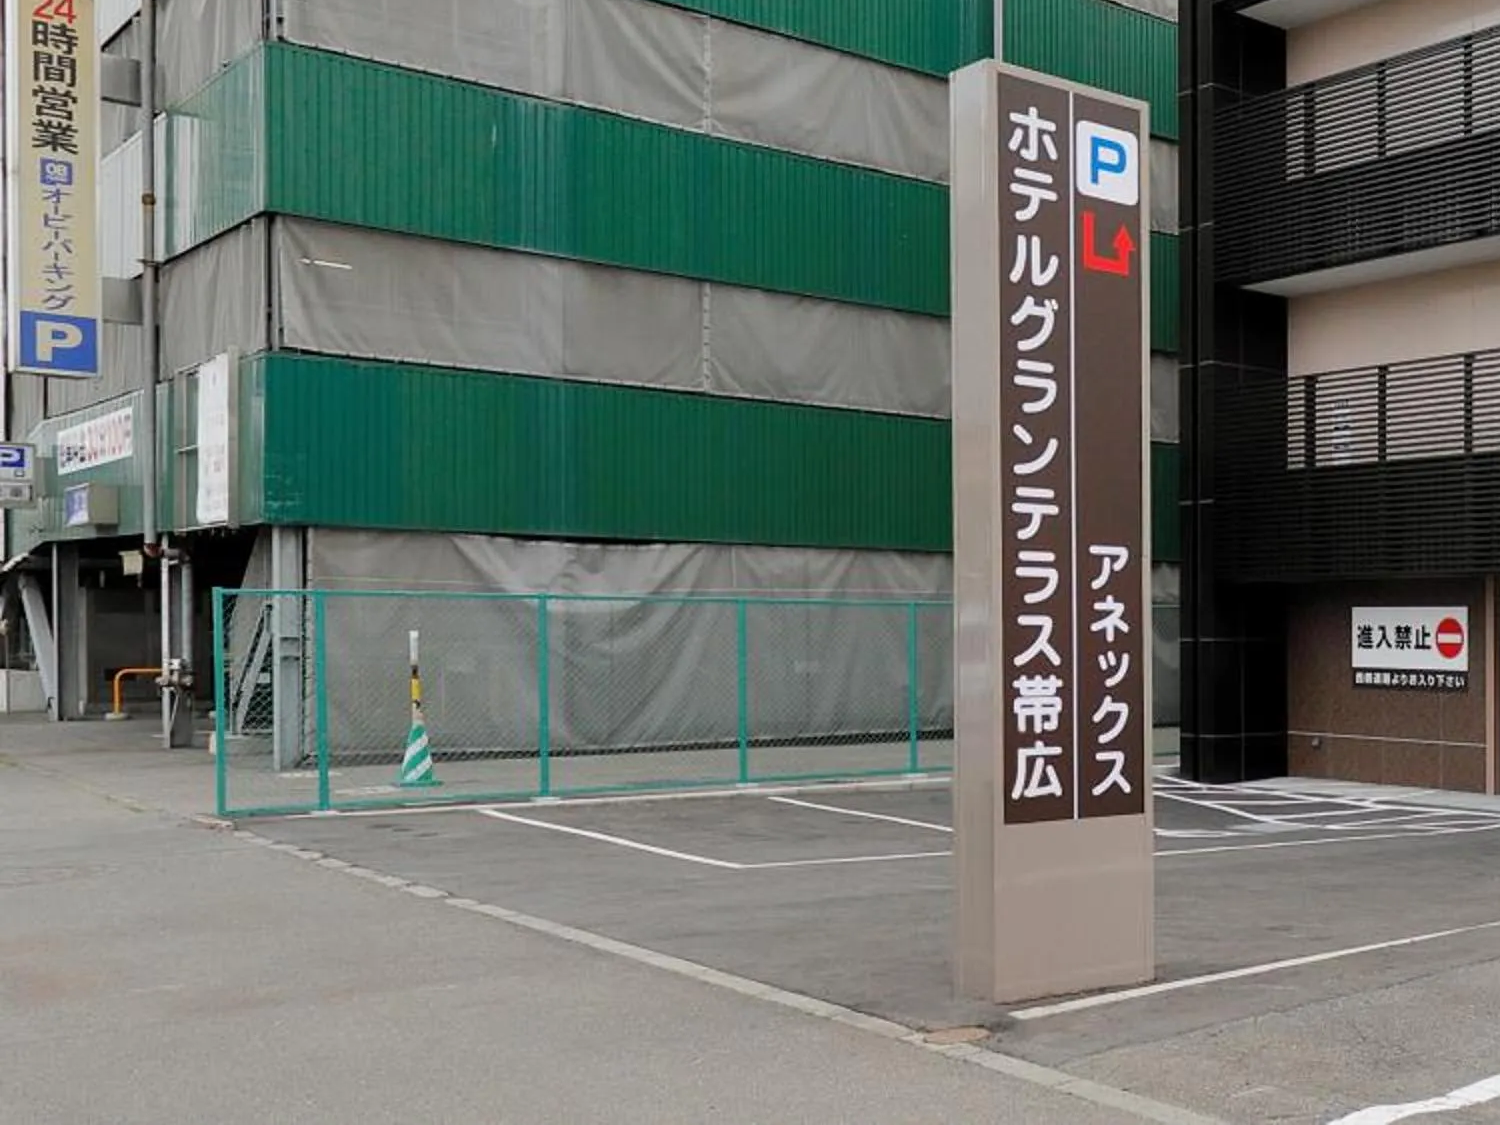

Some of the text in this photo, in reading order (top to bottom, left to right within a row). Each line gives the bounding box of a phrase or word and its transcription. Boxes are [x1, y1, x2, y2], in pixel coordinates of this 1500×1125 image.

[1090, 135, 1127, 185] P
[35, 321, 83, 364] P
[1007, 106, 1063, 800] ホテルグランテラス帯広
[1357, 624, 1431, 650] 進入禁止
[1088, 544, 1132, 796] アネックス
